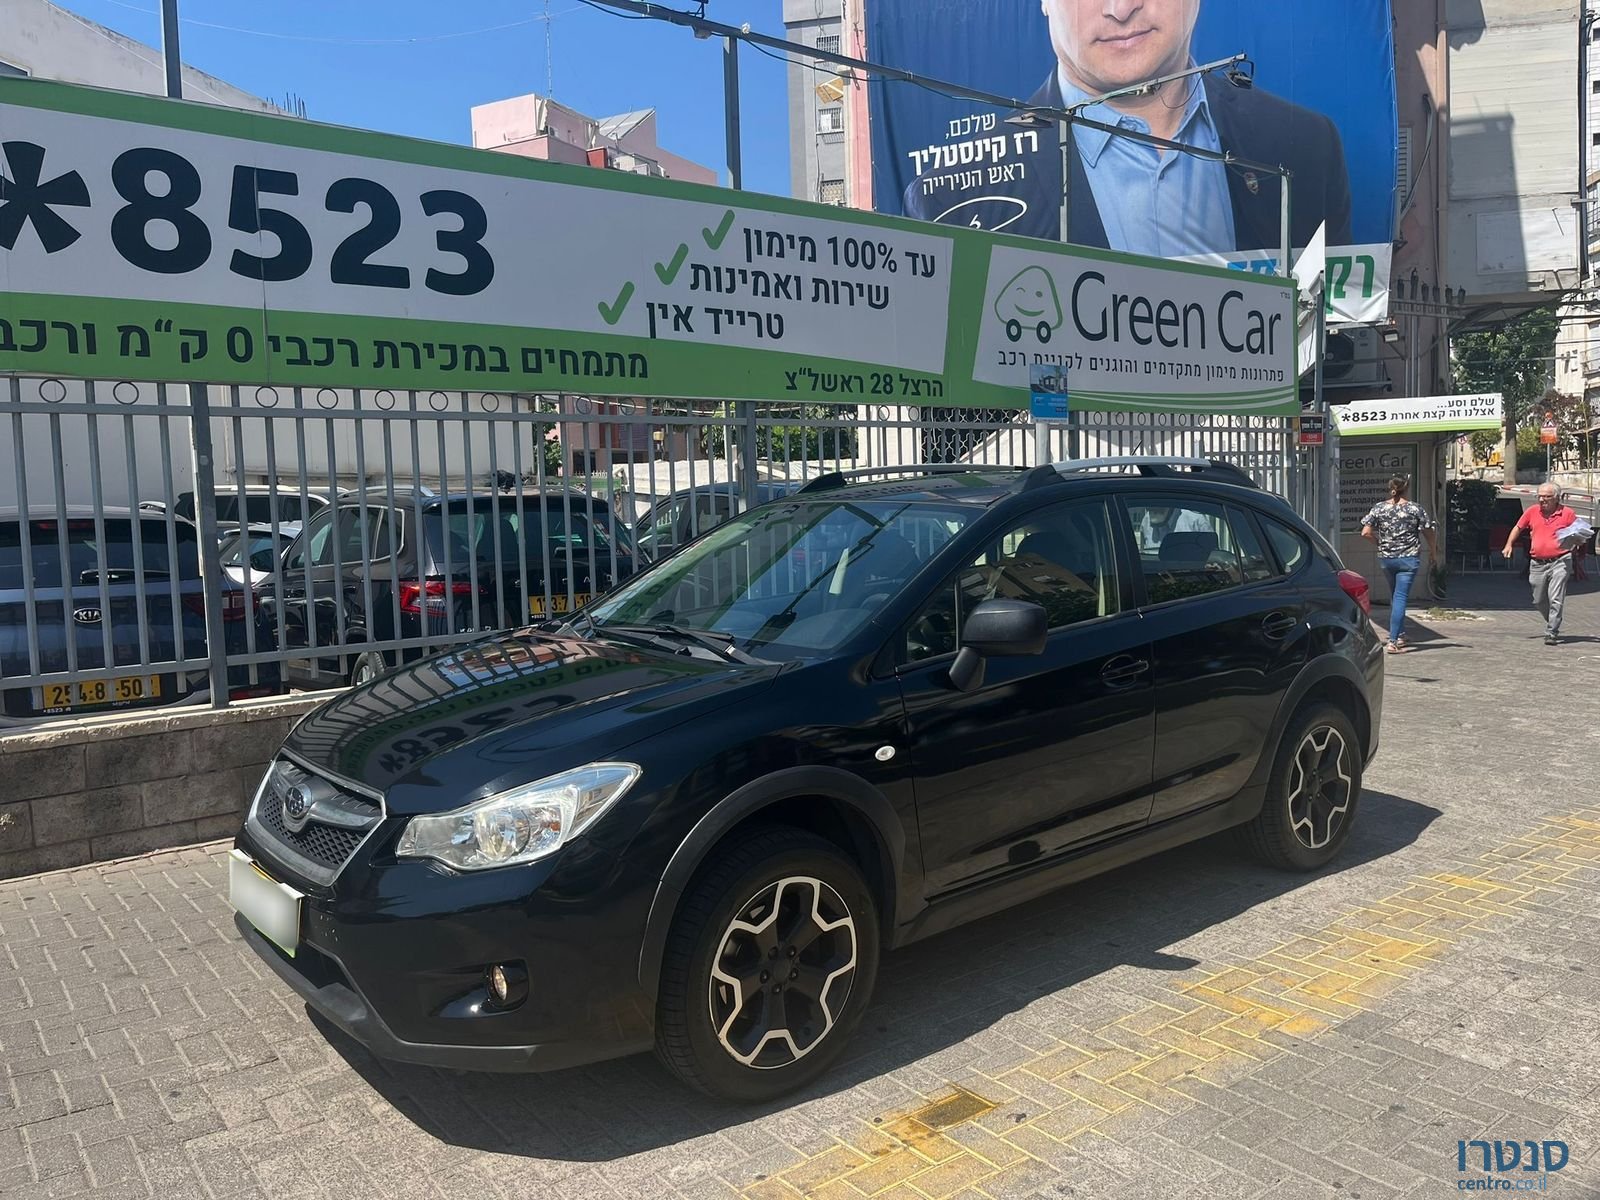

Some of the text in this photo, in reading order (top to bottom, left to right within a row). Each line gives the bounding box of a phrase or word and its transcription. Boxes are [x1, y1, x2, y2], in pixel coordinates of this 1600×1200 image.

[945, 113, 996, 139] שלכם,
[908, 131, 1038, 176] רז קינסטליך
[922, 163, 1025, 195] ראש העירייה
[744, 227, 935, 278] עד 100% מימון
[690, 263, 889, 310] שירות ואמינות
[646, 302, 784, 339] טרייד אין
[1072, 271, 1281, 355] Green Car
[227, 326, 254, 363] 0
[268, 335, 359, 367] רכבי
[373, 340, 509, 373] במכירת
[521, 347, 648, 378] מתמחים
[998, 350, 1026, 366] רכב
[1089, 357, 1138, 373] והוגנים
[1144, 361, 1201, 379] מתקדמים
[1206, 364, 1237, 381] מימון
[1241, 367, 1284, 382] פתרונות
[870, 373, 894, 395] 28
[899, 373, 943, 397] הרצל
[1464, 407, 1495, 417] אצלנו
[1470, 397, 1495, 407] שלם
[1391, 412, 1419, 420] אחרת
[1422, 410, 1446, 420] קצת
[1339, 453, 1408, 469] reen Car
[78, 610, 101, 621] KIA
